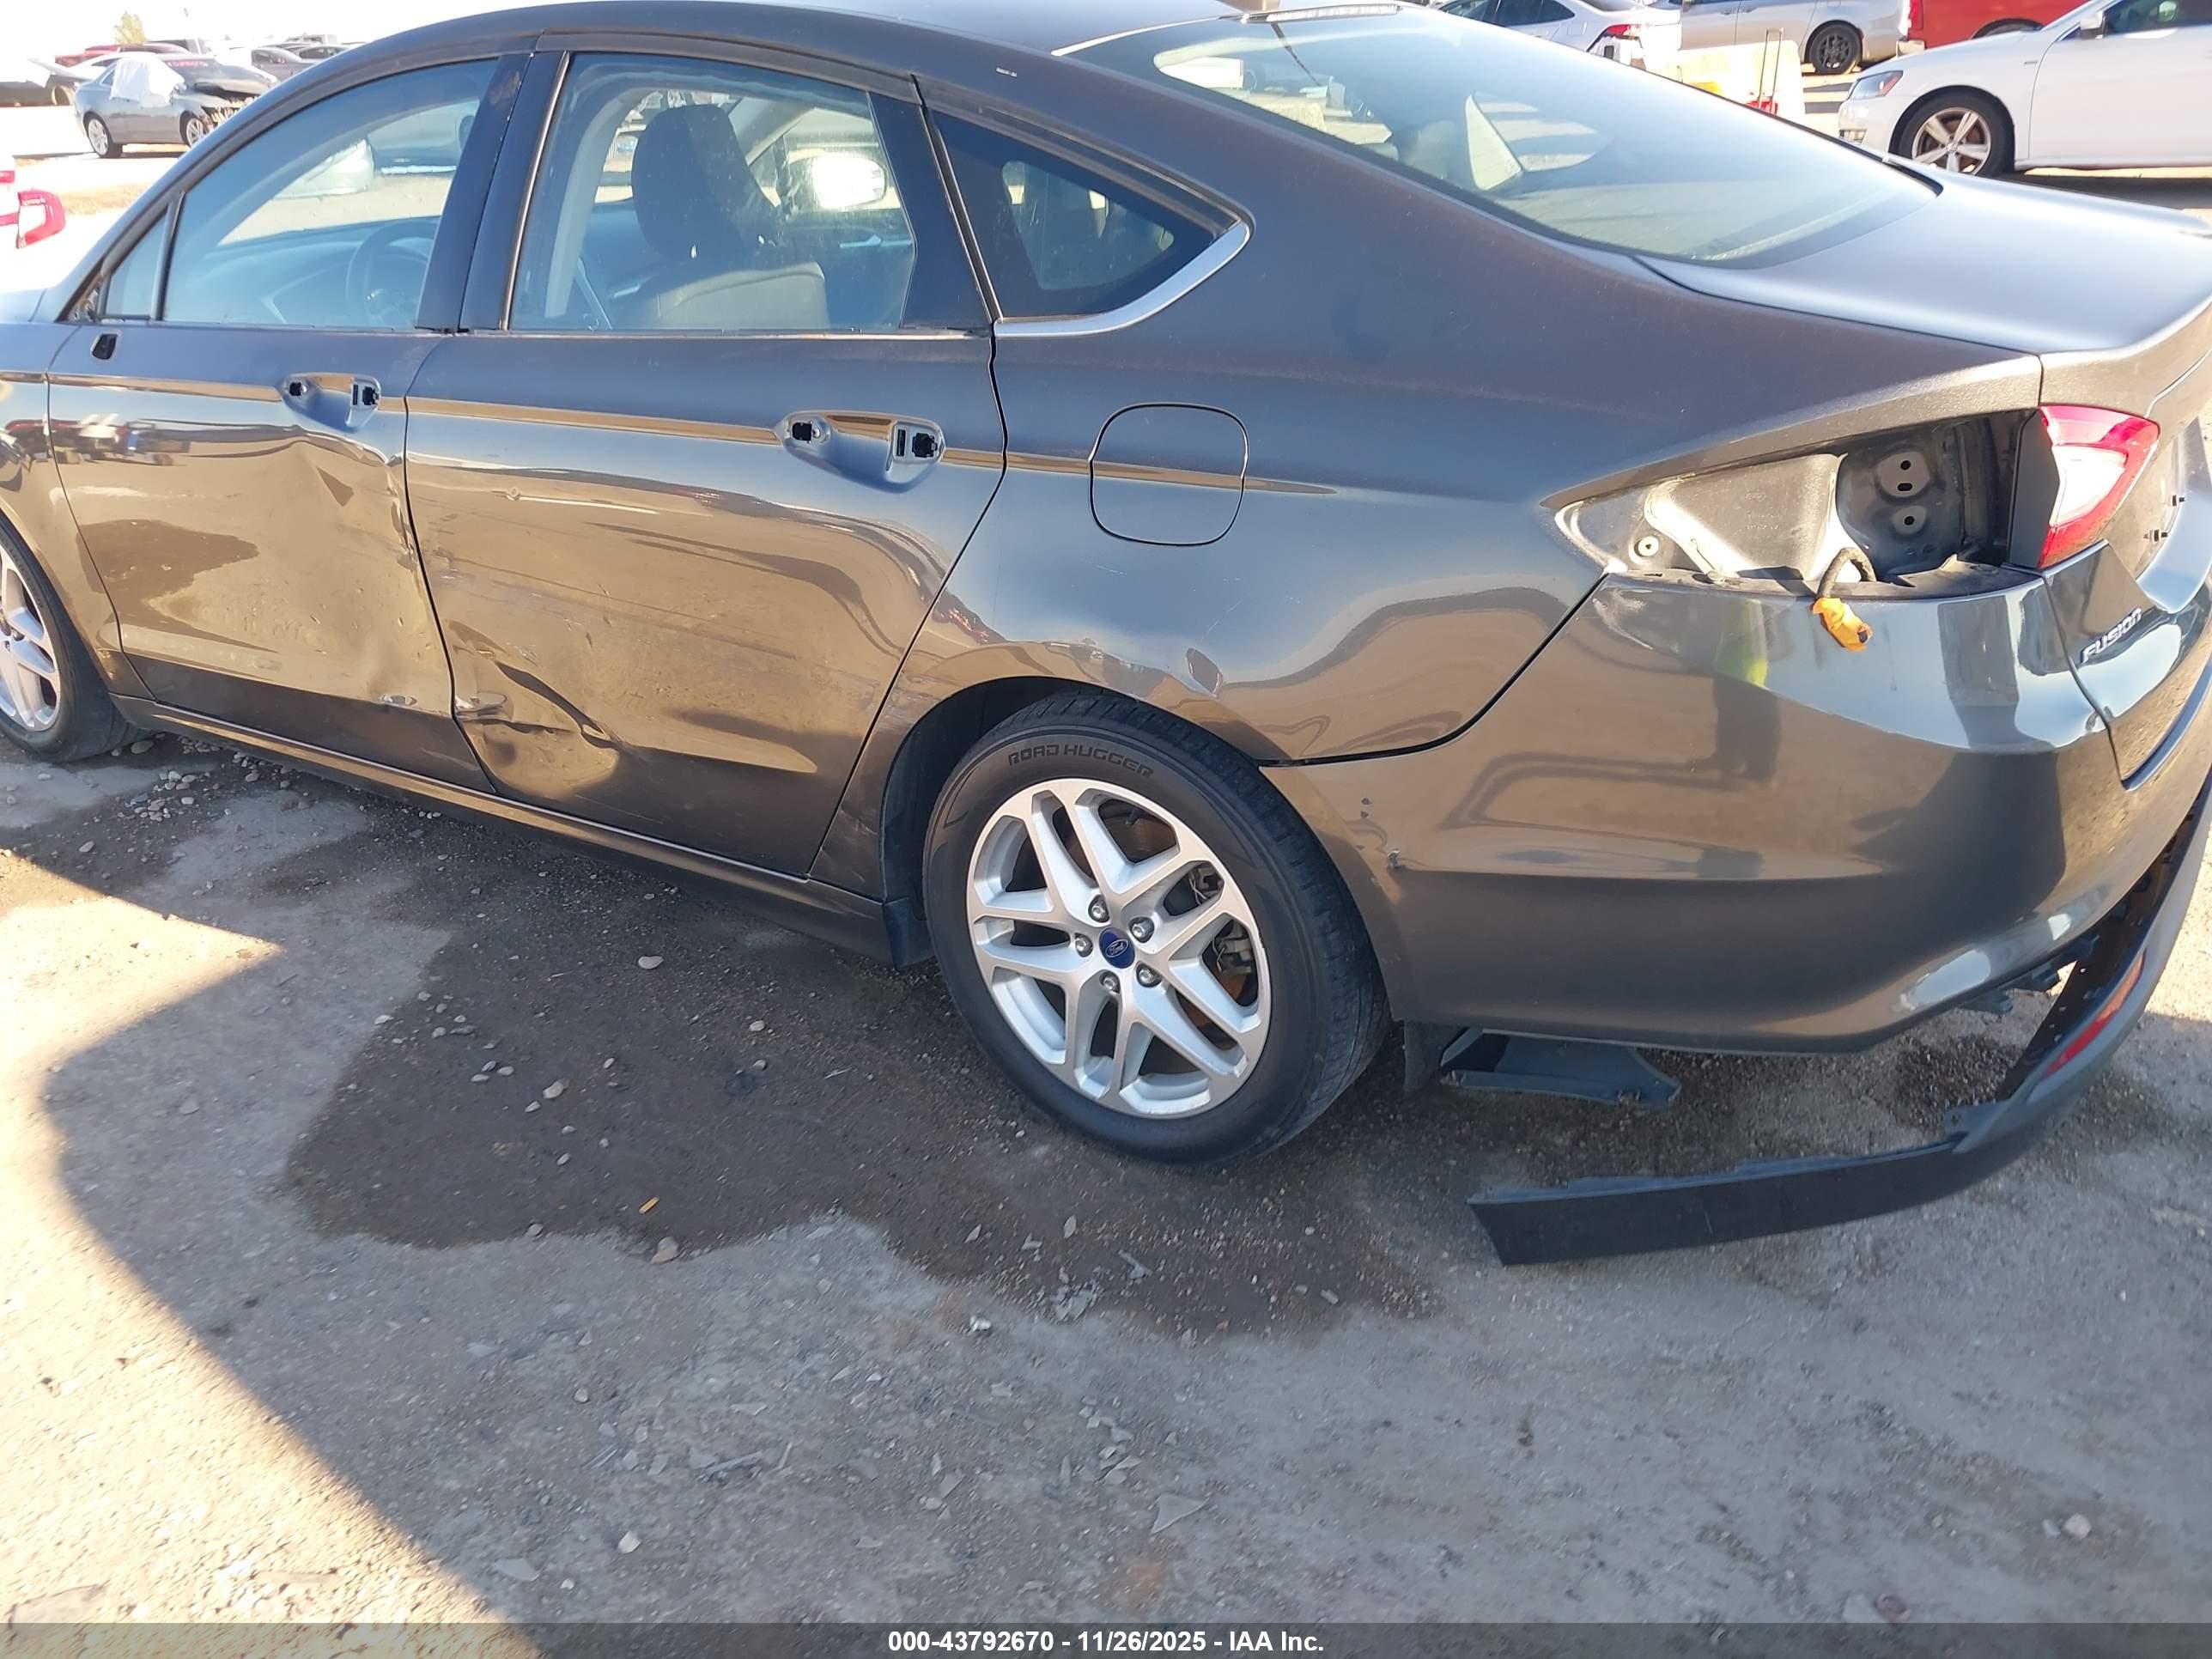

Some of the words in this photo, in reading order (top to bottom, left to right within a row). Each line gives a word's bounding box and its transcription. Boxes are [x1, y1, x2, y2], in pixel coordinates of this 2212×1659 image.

[1008, 744, 1060, 766] ROAD
[1064, 744, 1154, 777] HUGGER
[1108, 940, 1127, 956] Ford
